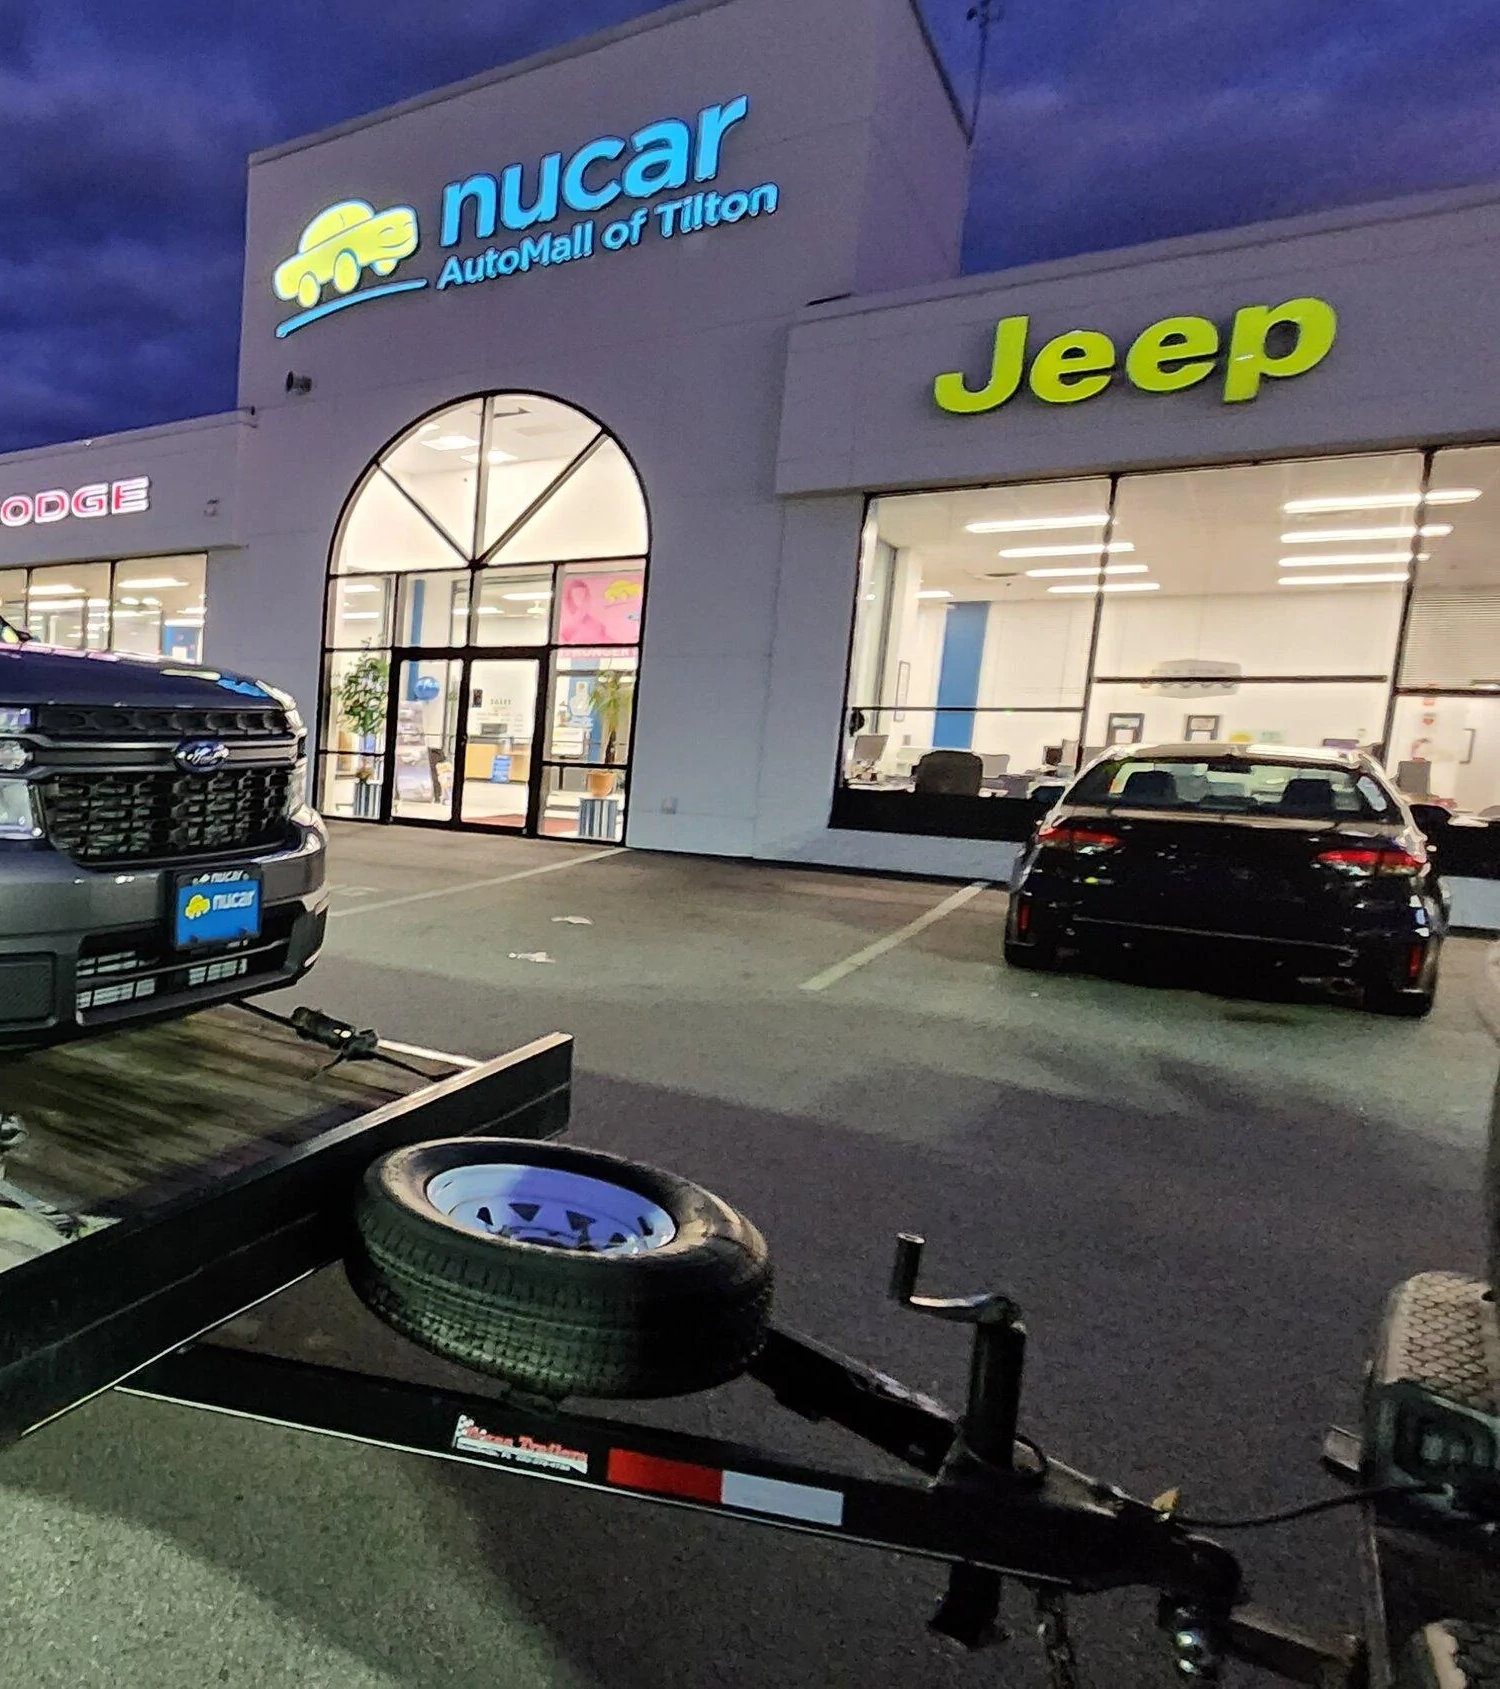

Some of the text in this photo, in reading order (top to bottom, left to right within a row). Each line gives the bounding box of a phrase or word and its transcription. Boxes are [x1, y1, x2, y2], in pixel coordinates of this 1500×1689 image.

[439, 94, 747, 246] nucar
[436, 183, 779, 289] AutoMall of Tilton
[933, 297, 1338, 414] Jeep
[213, 889, 257, 910] nucar
